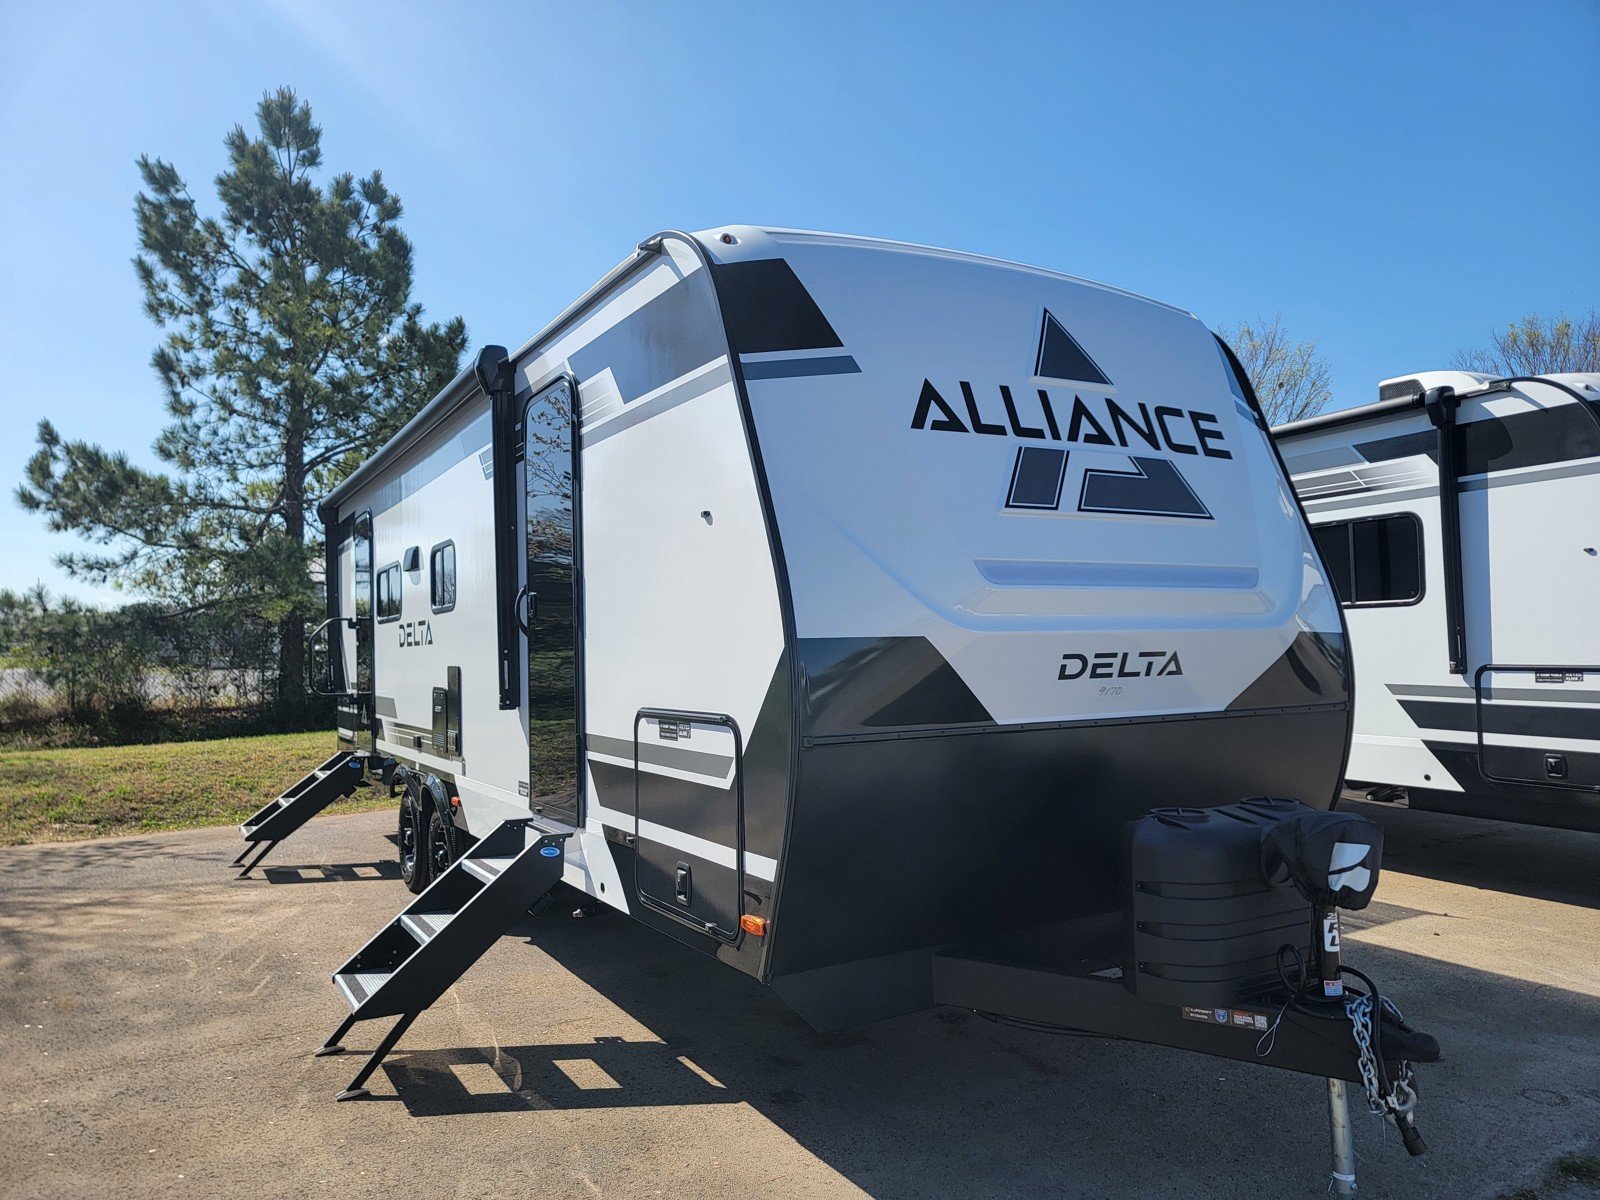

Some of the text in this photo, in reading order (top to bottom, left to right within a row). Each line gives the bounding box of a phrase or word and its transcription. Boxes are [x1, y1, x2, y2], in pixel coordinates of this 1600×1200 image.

[910, 377, 1233, 460] ALLIANCE
[399, 619, 433, 647] DELTA
[1058, 650, 1183, 680] DELTA
